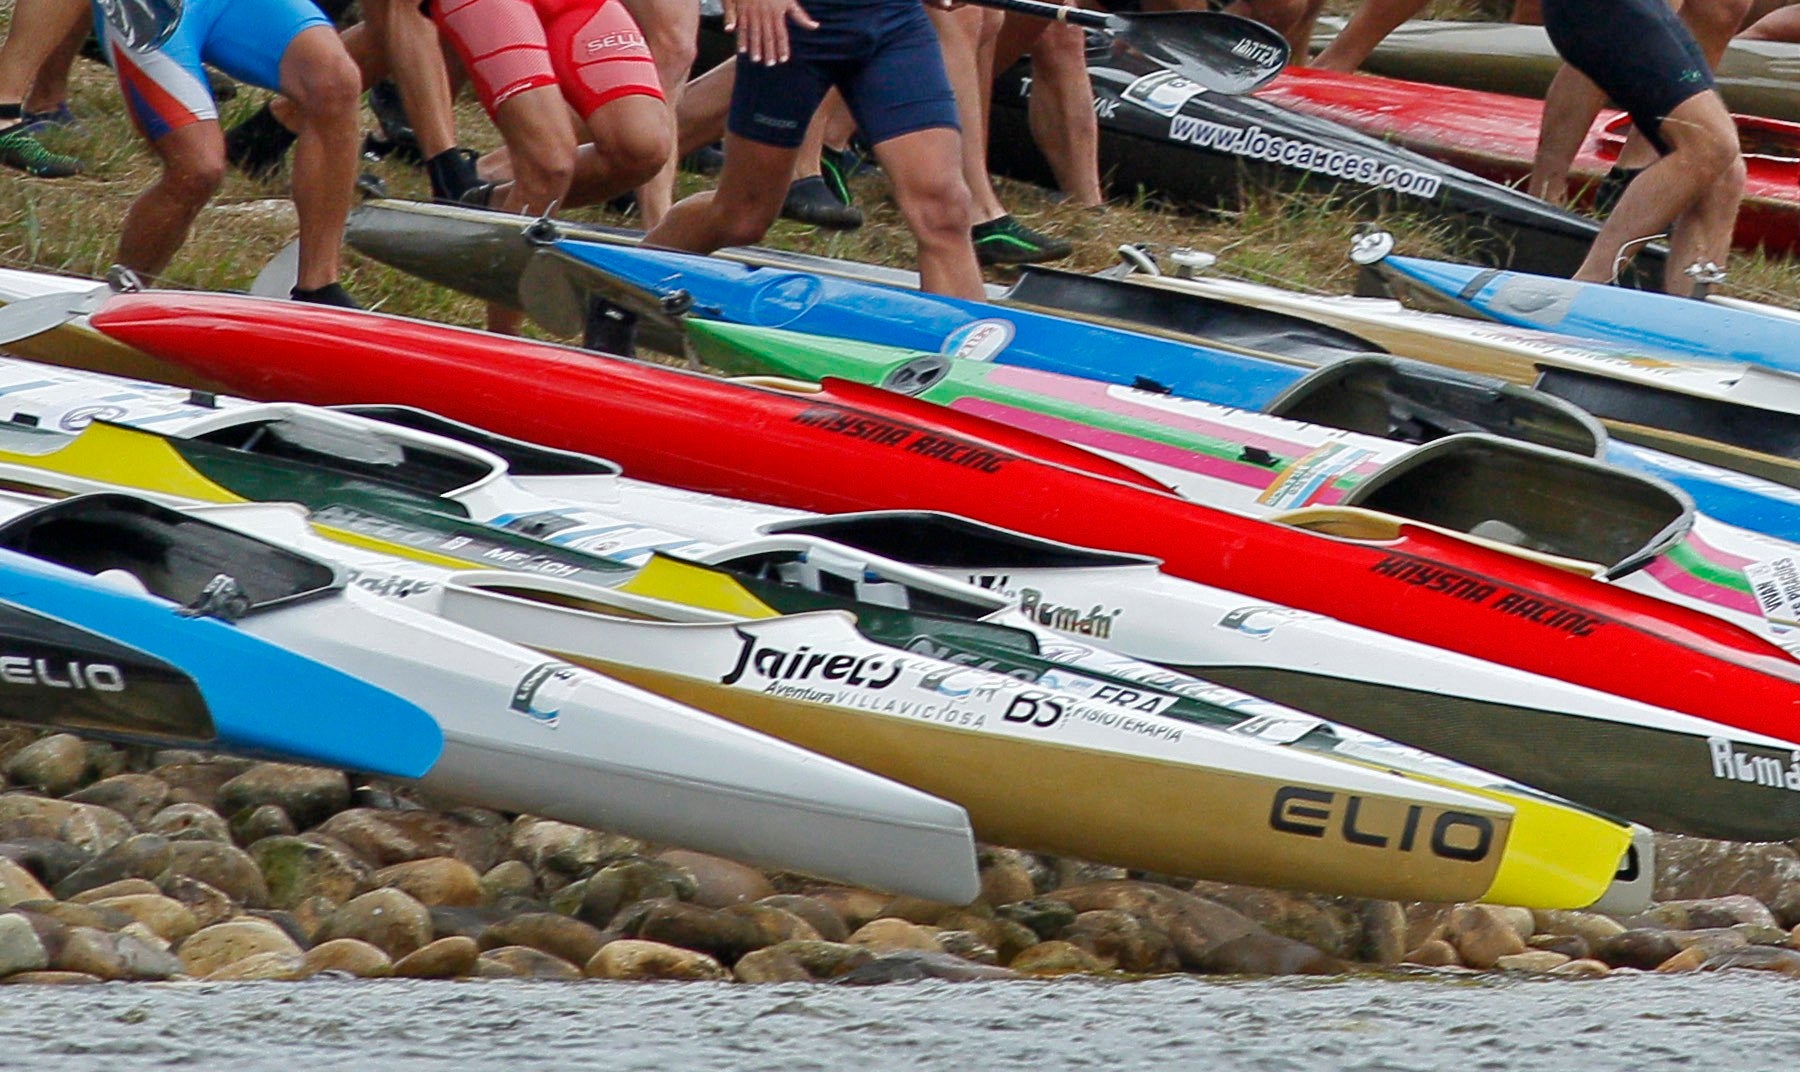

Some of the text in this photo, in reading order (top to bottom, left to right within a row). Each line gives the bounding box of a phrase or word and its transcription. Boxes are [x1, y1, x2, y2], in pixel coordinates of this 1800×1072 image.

[902, 434, 1010, 475] RACING
[1490, 591, 1604, 638] RACING
[0, 654, 126, 693] ELIO
[763, 679, 989, 731] Aventura VILLAVICIOSA
[1003, 690, 1058, 729] BS
[1087, 683, 1165, 716] FRA
[1268, 784, 1494, 863] ELIO
